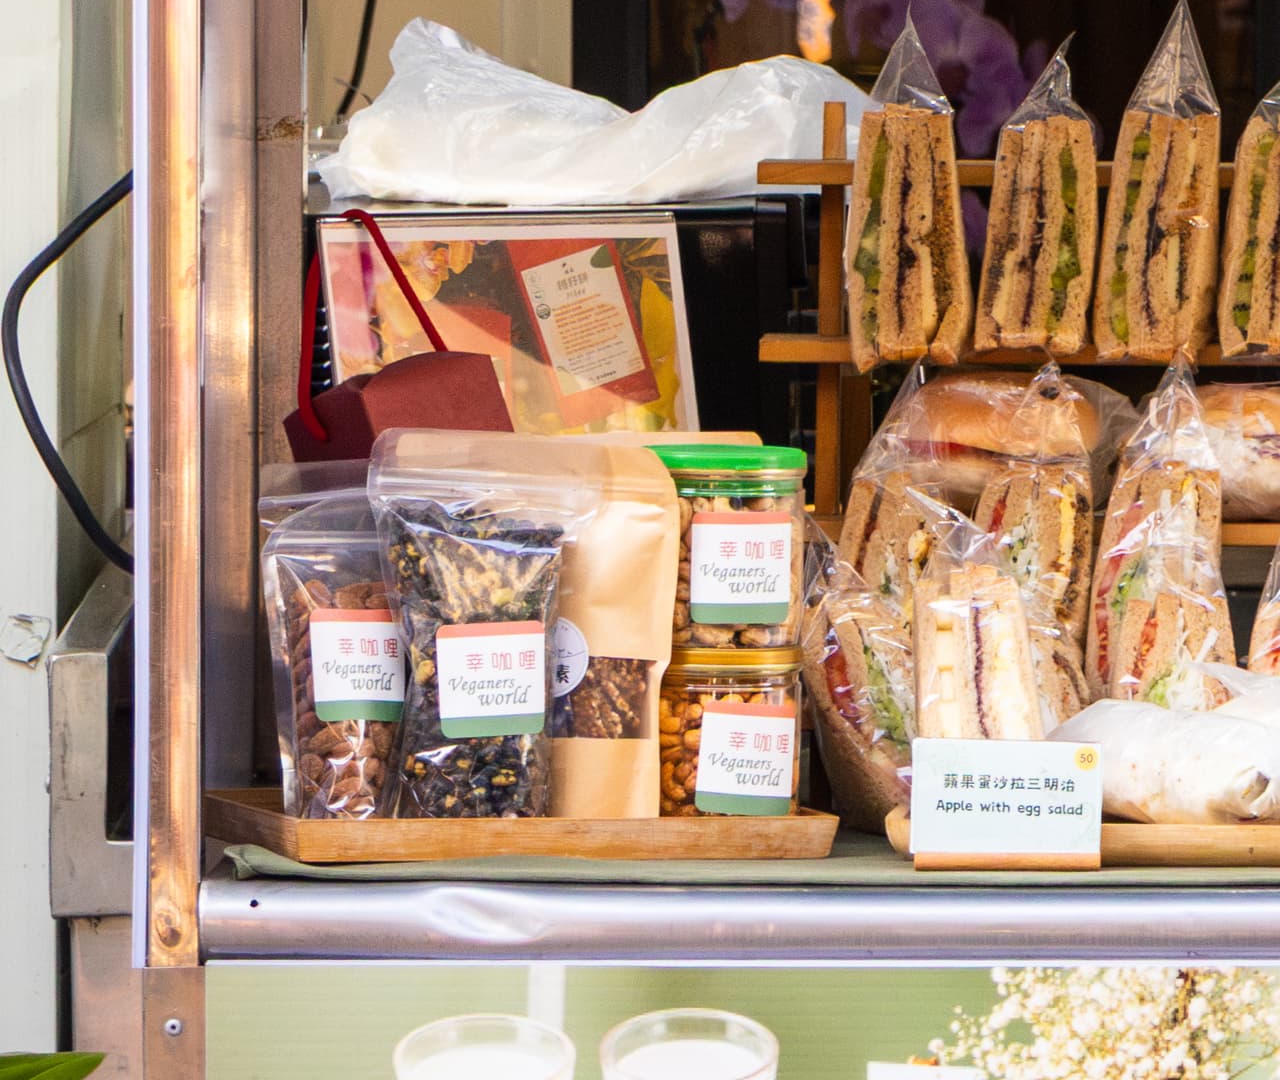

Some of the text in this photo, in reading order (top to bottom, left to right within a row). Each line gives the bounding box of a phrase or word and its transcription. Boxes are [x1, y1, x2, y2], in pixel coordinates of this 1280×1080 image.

[699, 562, 766, 582] Veganers
[728, 573, 780, 594] world
[322, 659, 382, 679] Veganers
[351, 672, 395, 691] world
[448, 676, 515, 695] Veganers
[478, 685, 532, 706] world
[708, 752, 773, 772] Veganers
[1079, 753, 1093, 763] 50
[736, 768, 784, 786] world
[944, 773, 1076, 792] 蘋果蛋沙拉三明治
[936, 799, 1083, 816] Apple with egg salad
